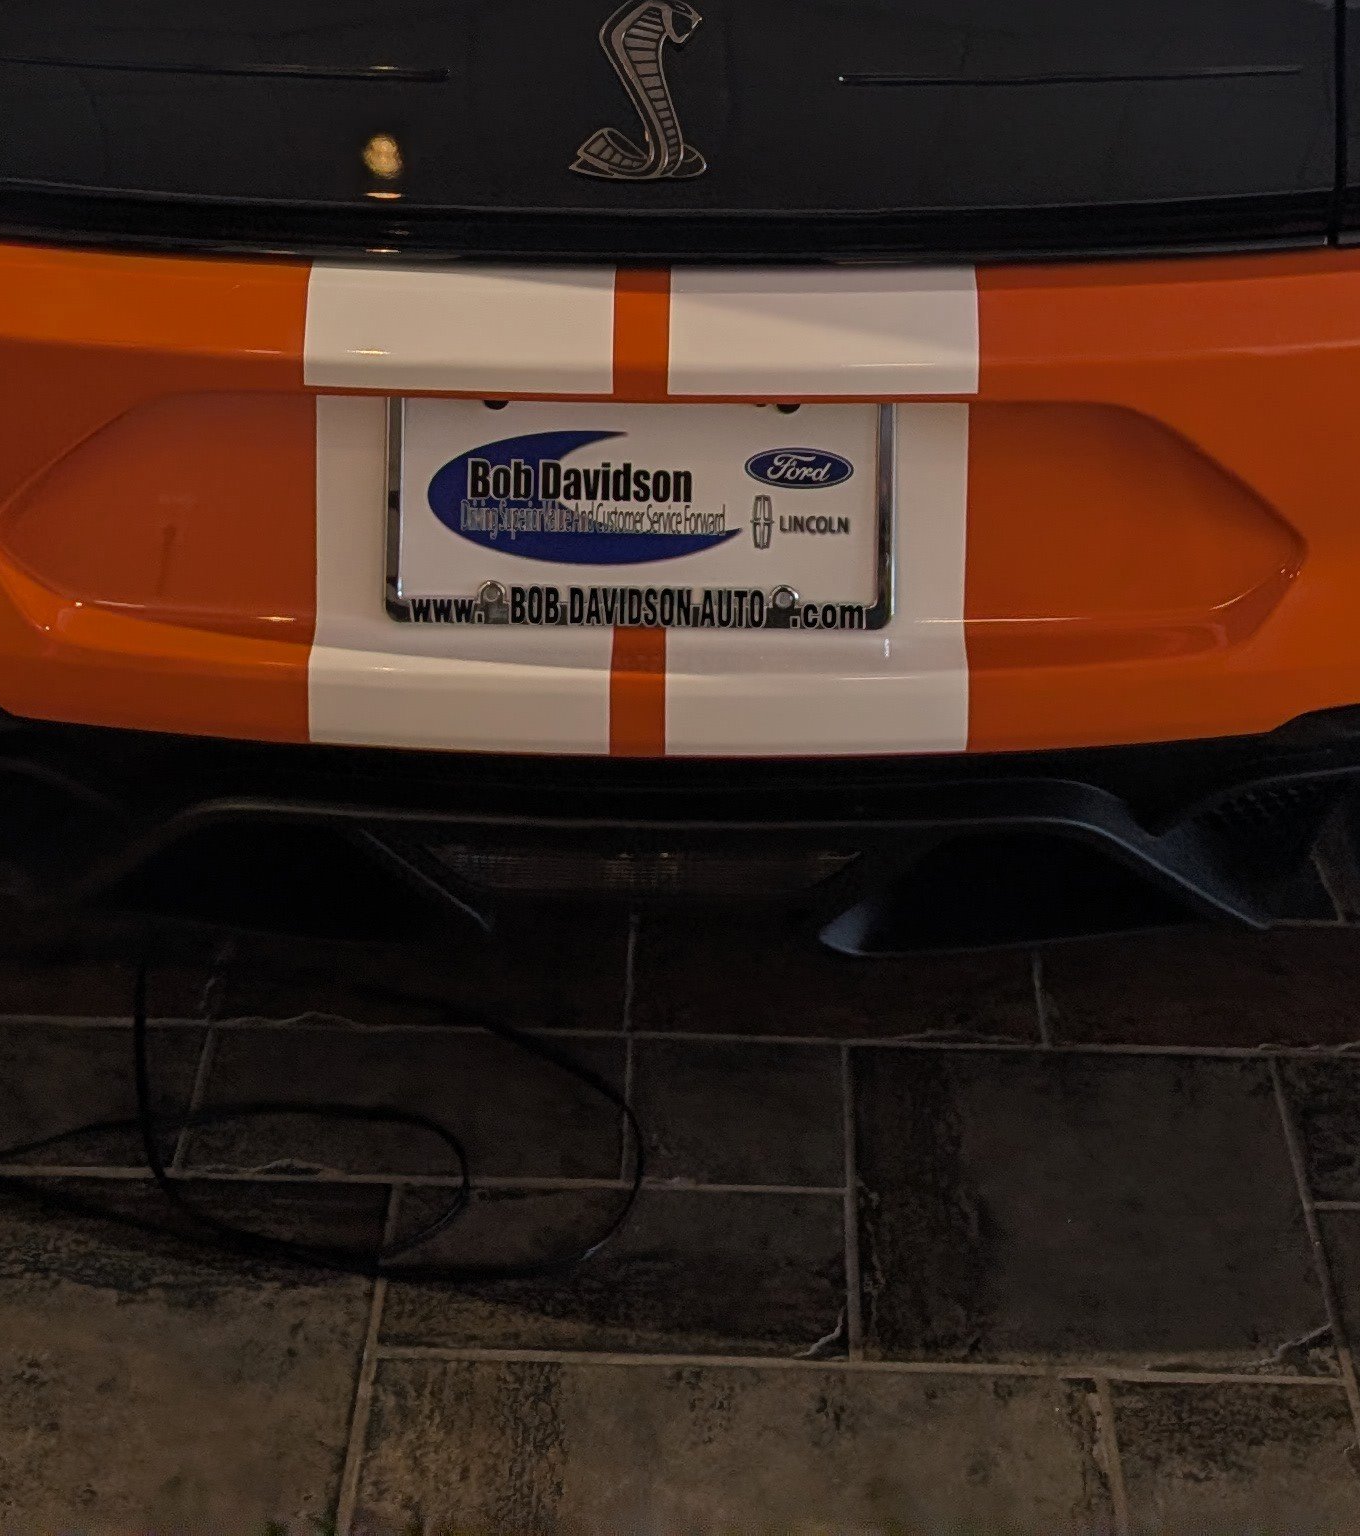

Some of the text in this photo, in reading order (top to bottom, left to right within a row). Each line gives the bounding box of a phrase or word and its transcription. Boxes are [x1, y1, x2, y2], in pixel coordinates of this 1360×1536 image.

[469, 460, 692, 503] Bob Davidson
[766, 453, 832, 482] Ford
[460, 499, 726, 540] Driving Superior Value And Customer Service Forward
[779, 515, 850, 534] LINCOLN
[410, 586, 866, 629] www. BOB DAVIDSON AUTO .com
